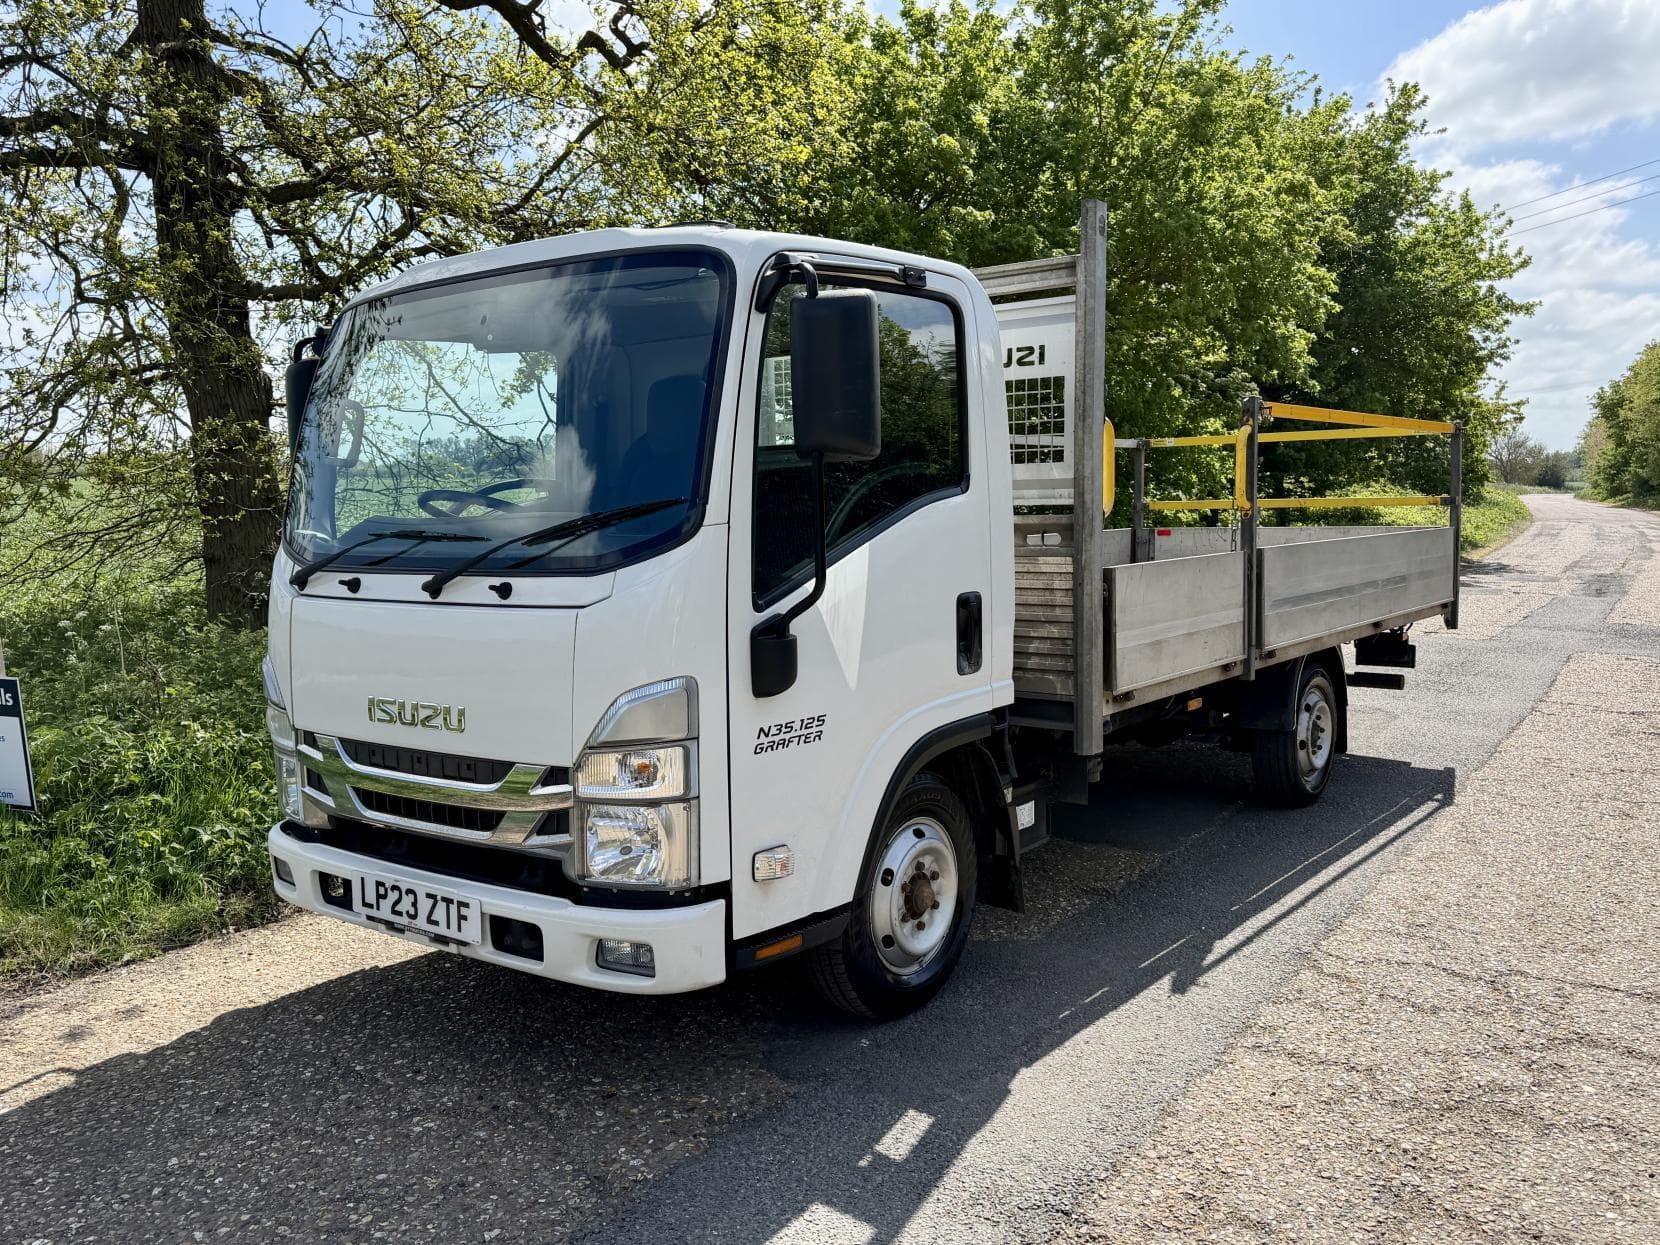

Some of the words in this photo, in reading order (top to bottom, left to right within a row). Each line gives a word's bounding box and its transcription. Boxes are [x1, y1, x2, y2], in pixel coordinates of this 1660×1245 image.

[0, 688, 13, 706] ls
[367, 695, 466, 733] ISUZU
[757, 714, 827, 740] N35.125
[754, 730, 823, 755] GRAFTER
[360, 876, 419, 921] LP23
[425, 892, 470, 933] ZTF
